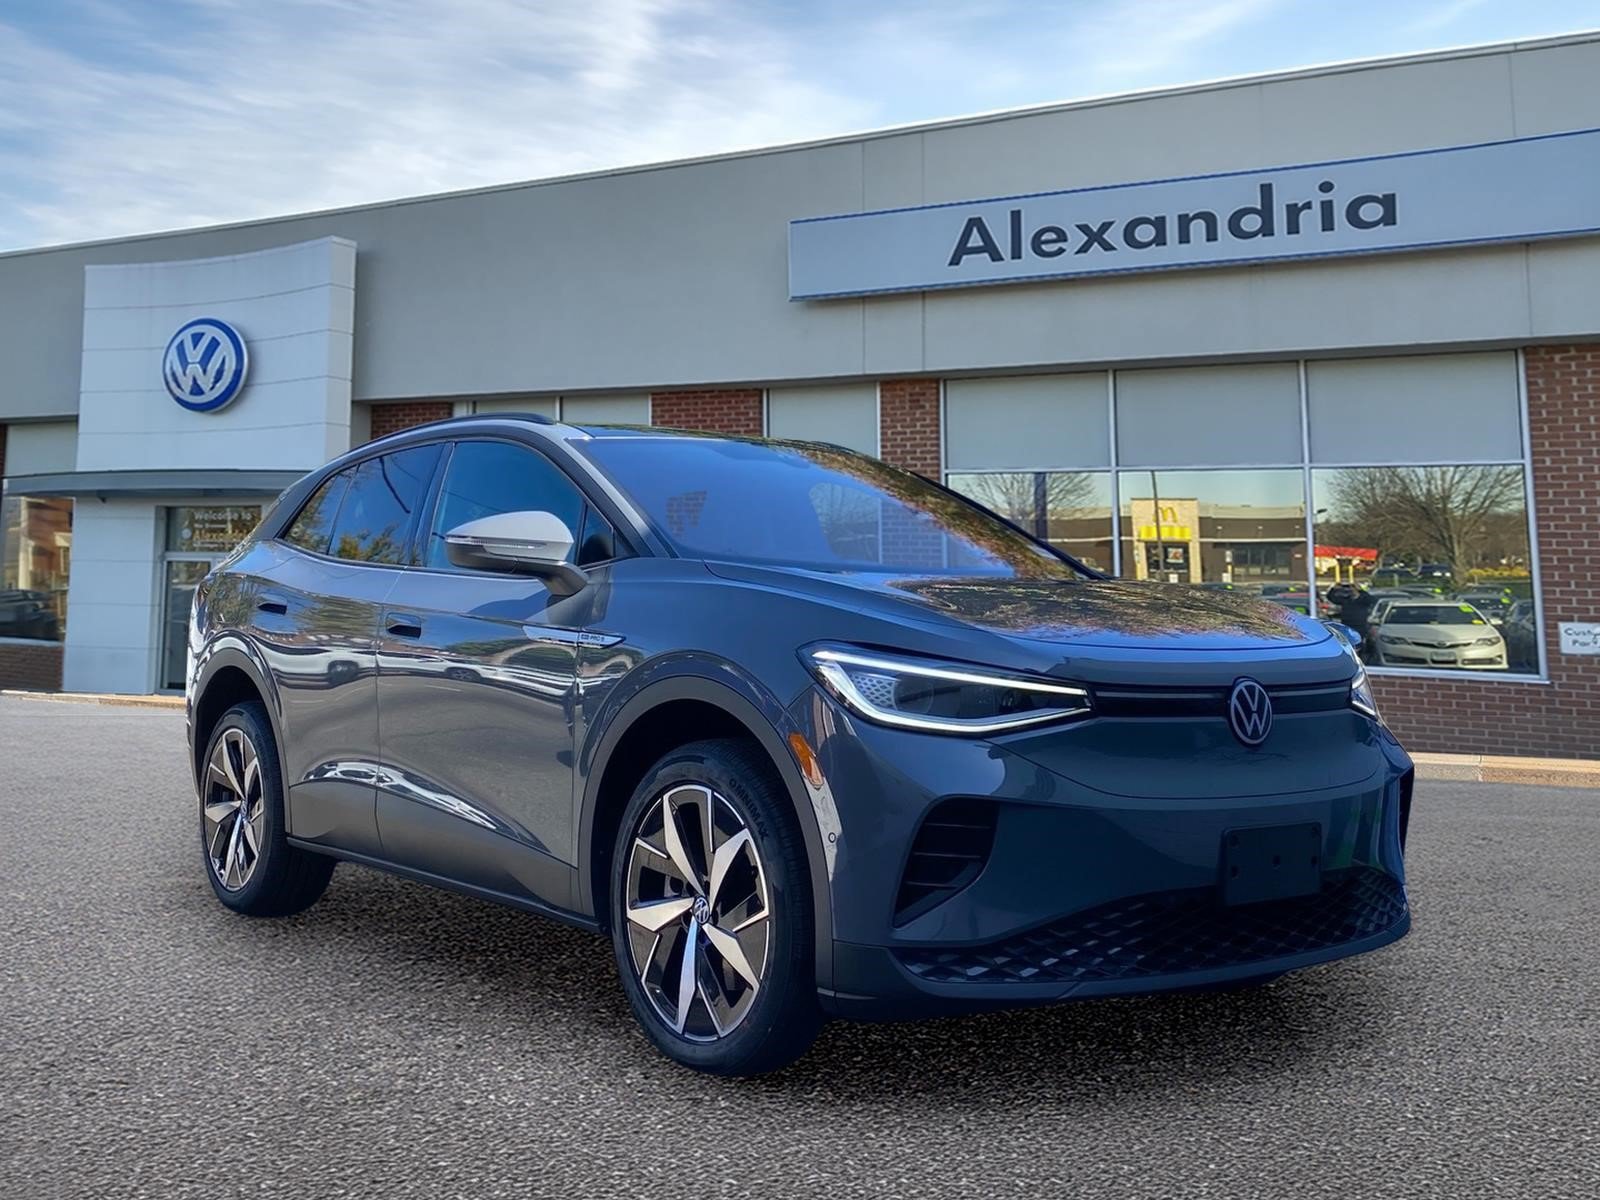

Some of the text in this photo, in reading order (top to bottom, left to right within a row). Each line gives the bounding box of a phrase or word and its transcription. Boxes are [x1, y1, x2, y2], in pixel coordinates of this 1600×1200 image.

[947, 181, 1398, 267] Alexandria
[165, 323, 237, 404] VW
[1232, 682, 1271, 742] VW
